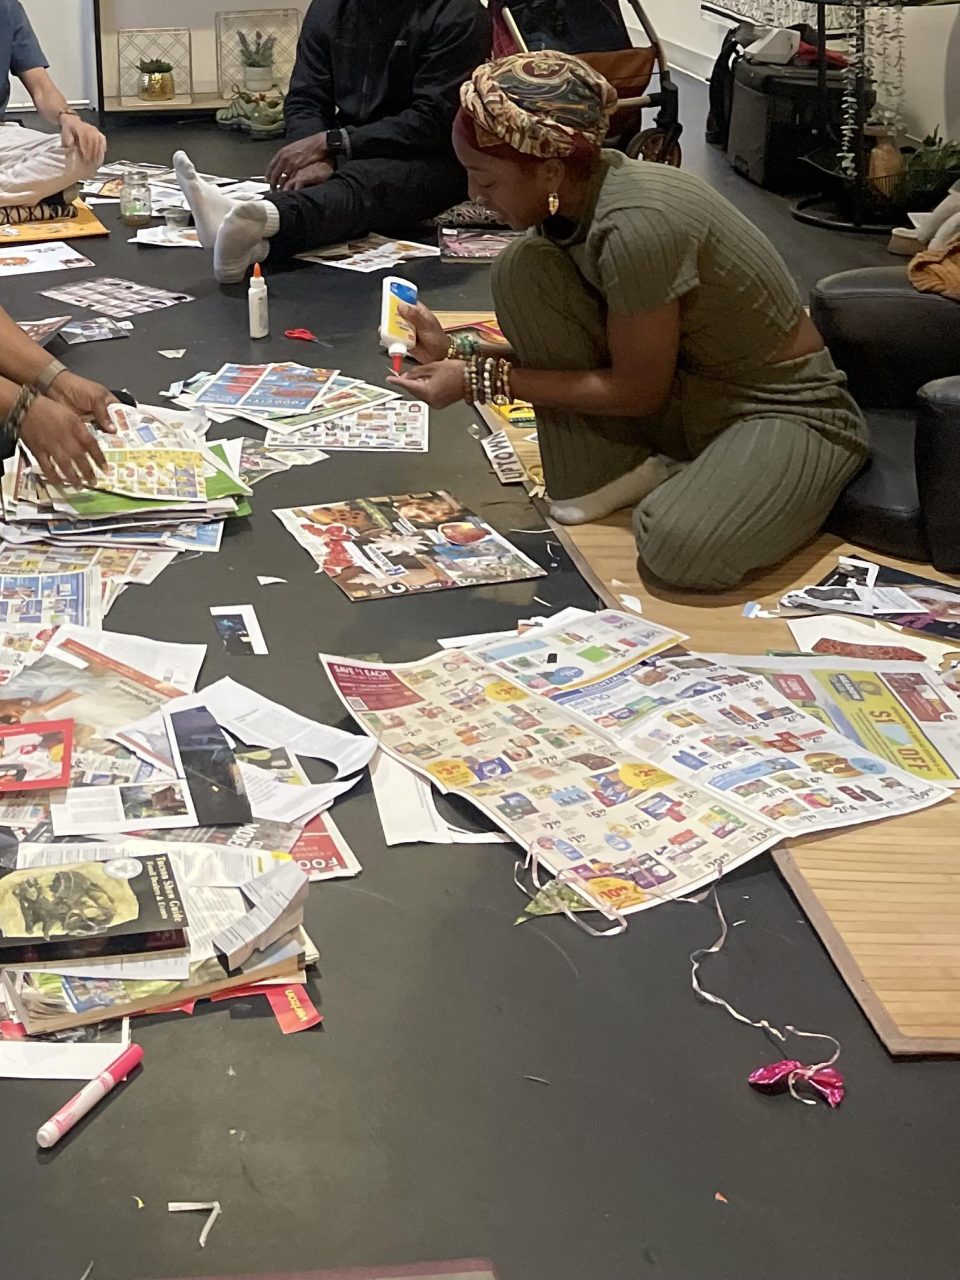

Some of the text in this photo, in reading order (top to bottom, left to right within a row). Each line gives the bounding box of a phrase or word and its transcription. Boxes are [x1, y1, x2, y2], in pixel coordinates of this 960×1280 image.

[299, 857, 339, 869] FOO
[155, 856, 184, 923] Tucson Show Guide
[285, 988, 308, 1022] verizon
